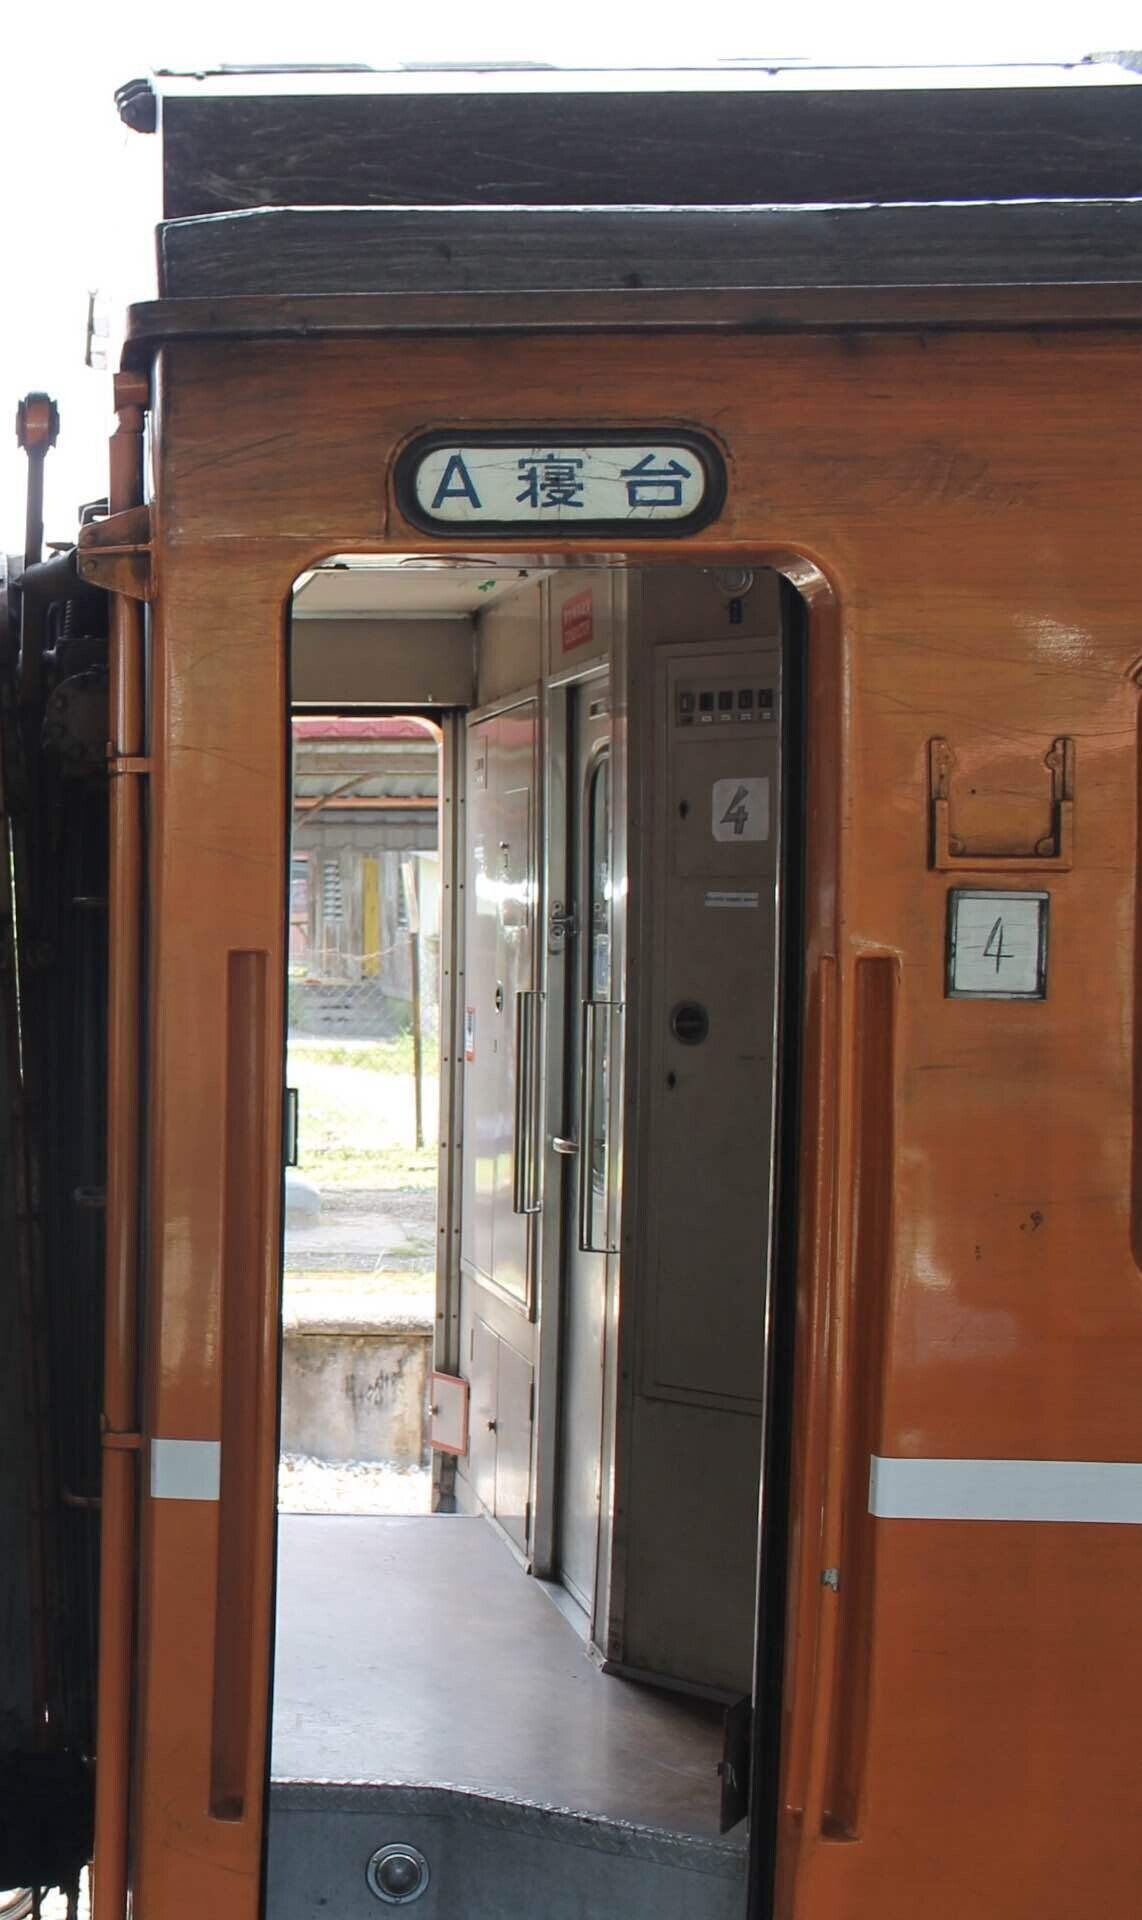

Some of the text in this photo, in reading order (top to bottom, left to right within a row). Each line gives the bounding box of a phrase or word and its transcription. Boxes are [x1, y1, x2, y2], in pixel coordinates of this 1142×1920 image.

[431, 454, 482, 509] A
[719, 784, 750, 835] 4
[983, 916, 1015, 974] 4
